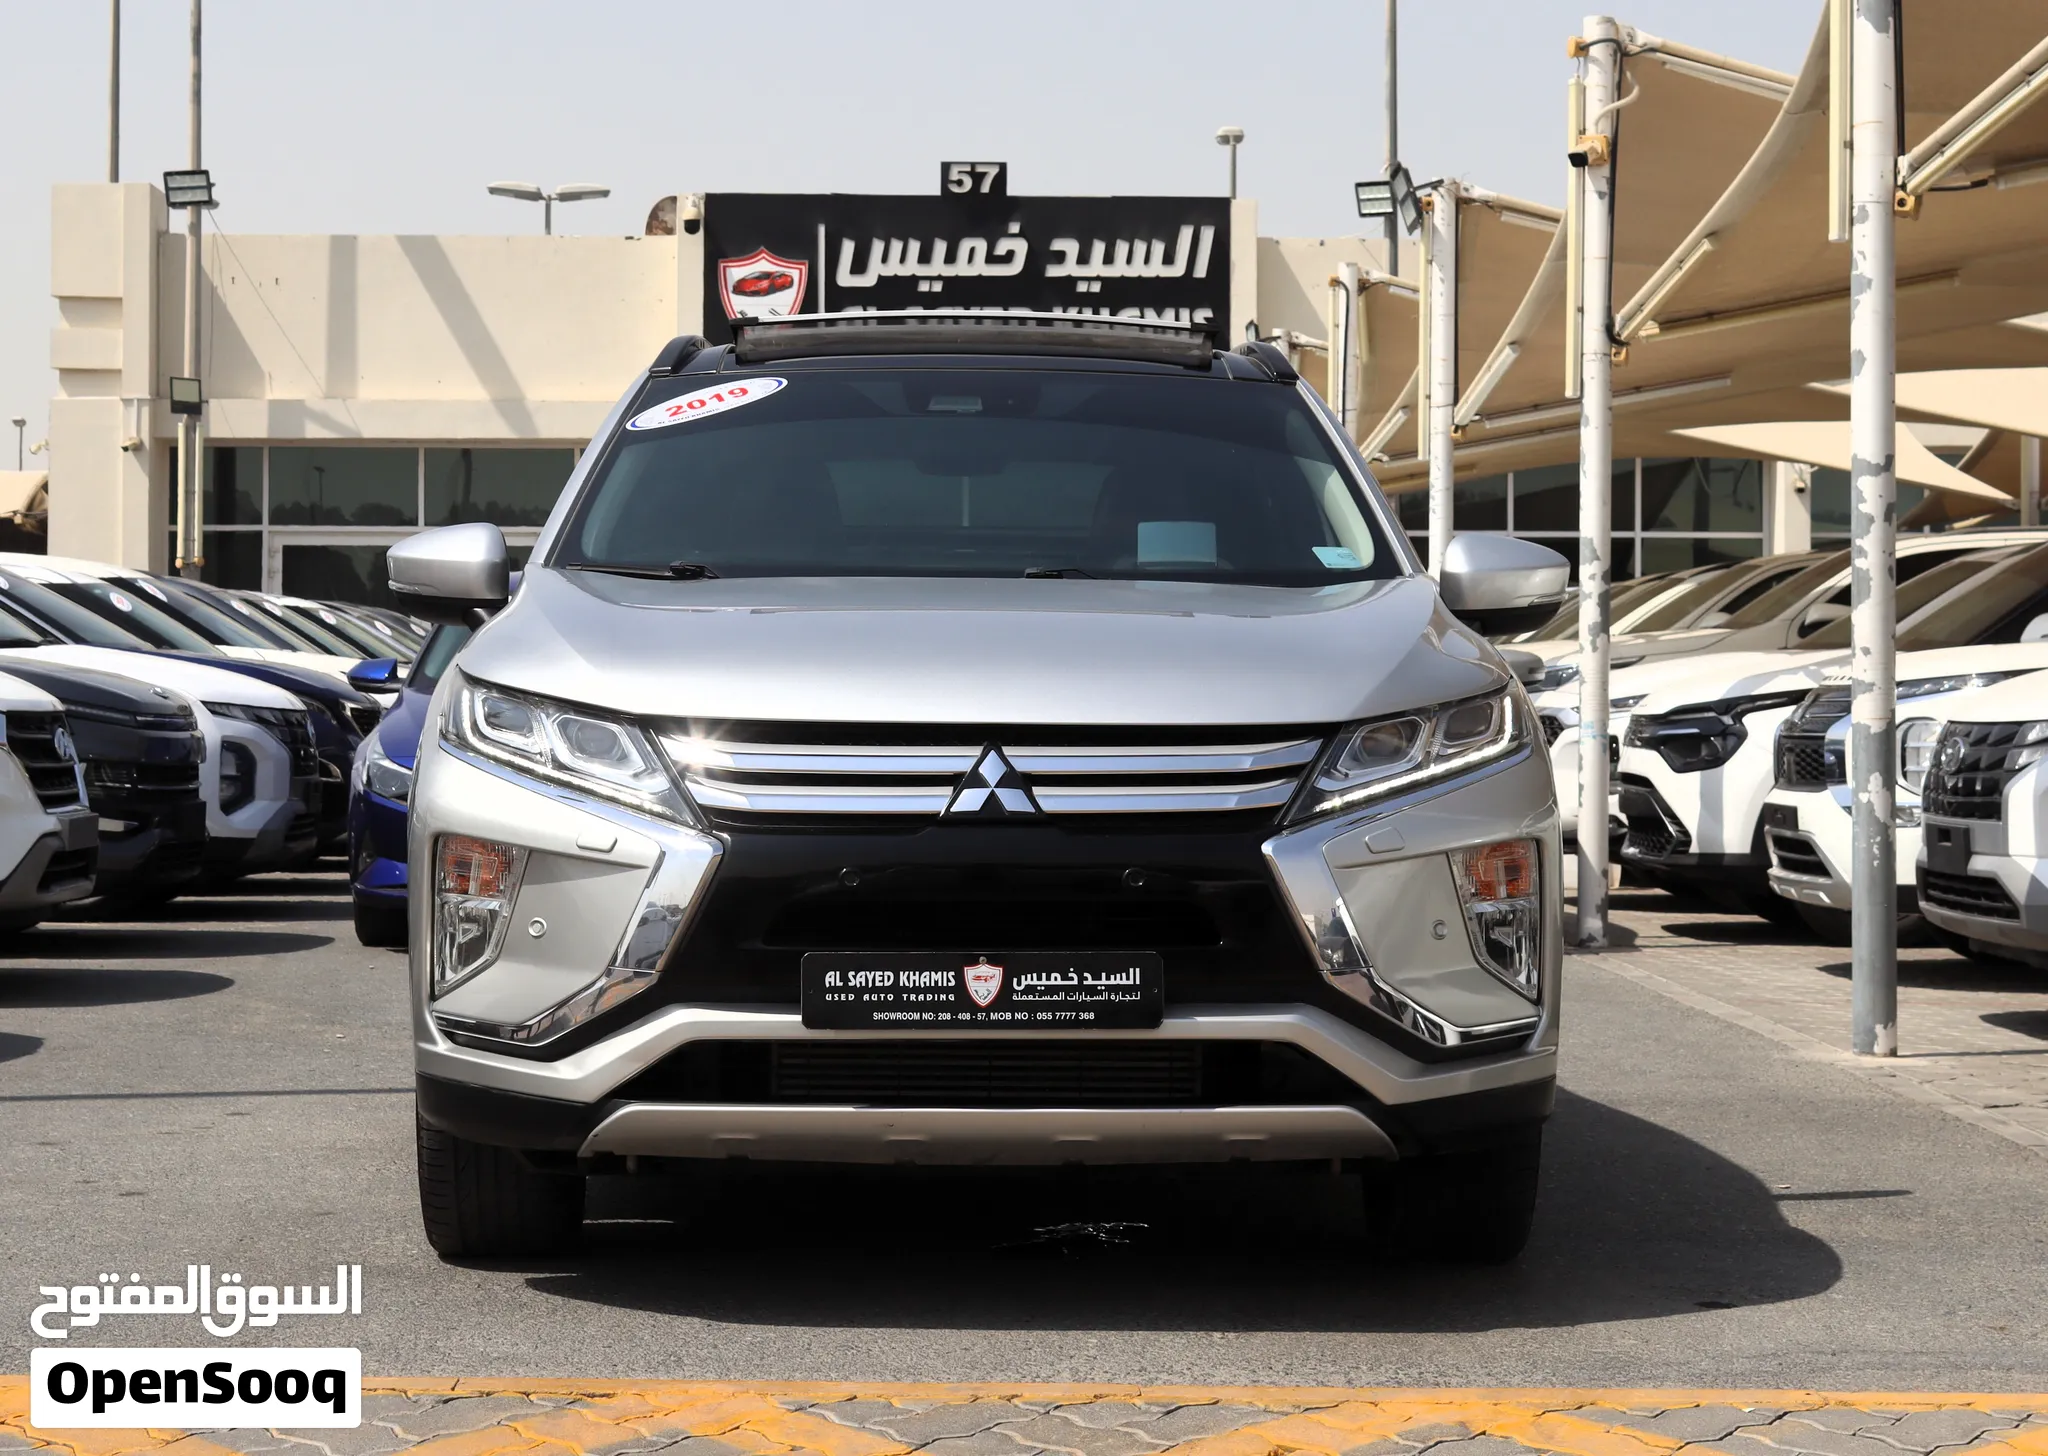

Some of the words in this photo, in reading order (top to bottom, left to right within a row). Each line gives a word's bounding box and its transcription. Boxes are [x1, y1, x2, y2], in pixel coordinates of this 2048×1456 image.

[947, 164, 1000, 194] 57
[835, 221, 1029, 293] خميس
[1044, 224, 1216, 293] السيد
[665, 387, 749, 418] 2019
[824, 970, 844, 988] AL
[847, 970, 895, 989] SAYED
[899, 970, 956, 989] KHAMIS
[1012, 967, 1079, 991] خميس
[1082, 967, 1141, 990] السيد
[825, 993, 855, 1002] USED
[862, 993, 894, 1002] AUTO
[901, 993, 955, 1002] TRADING
[1012, 991, 1065, 1002] المستعملة
[1066, 991, 1109, 1003] السيارات
[1109, 991, 1141, 1003] لتجارة
[872, 1011, 921, 1021] SHOWROOM
[921, 1011, 937, 1021] NO:
[937, 1012, 952, 1021] 208
[957, 1012, 971, 1021] 408
[976, 1012, 989, 1022] 57,
[989, 1011, 1012, 1021] MOB
[1014, 1011, 1029, 1021] NO
[1036, 1011, 1053, 1021] 055
[1054, 1011, 1077, 1021] 7777
[1078, 1011, 1095, 1021] 368
